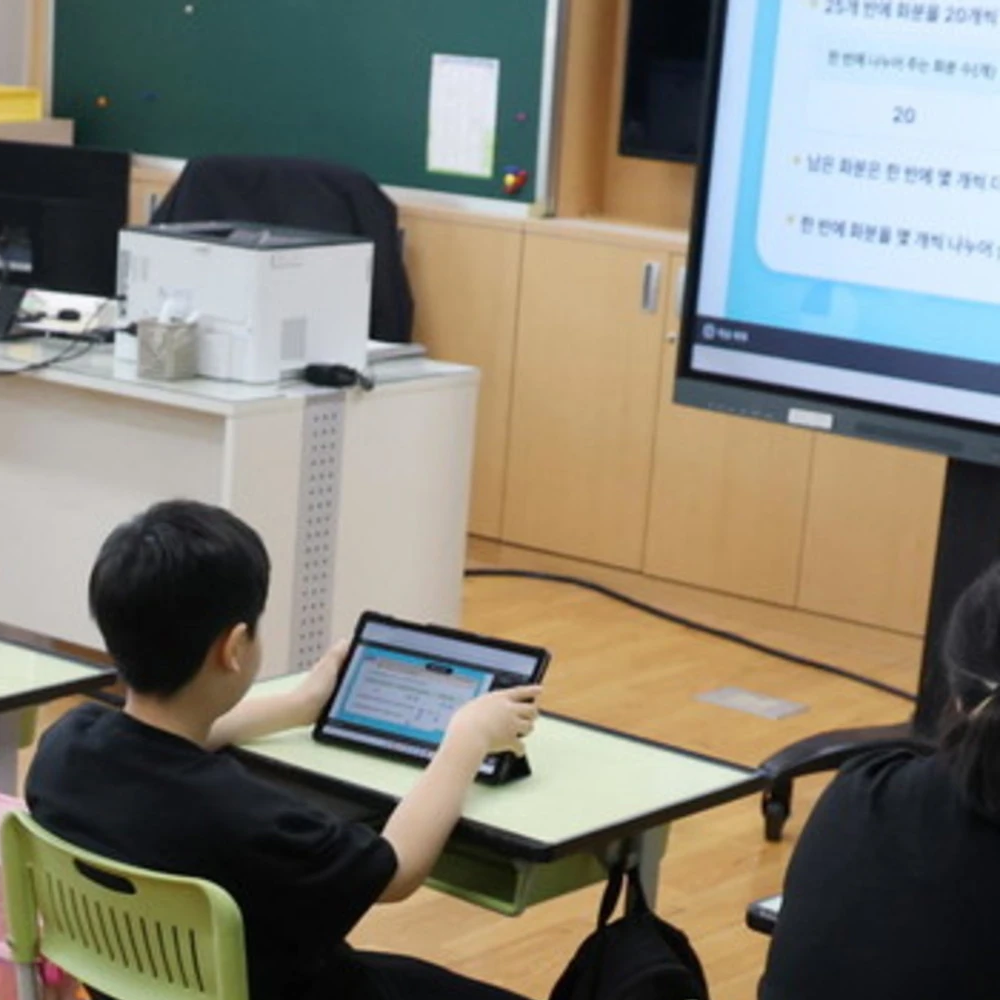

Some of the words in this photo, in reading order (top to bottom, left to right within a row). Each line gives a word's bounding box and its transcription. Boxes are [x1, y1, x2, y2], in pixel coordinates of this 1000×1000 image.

[893, 105, 917, 124] 20
[807, 152, 834, 174] 남은
[887, 161, 901, 182] 한
[904, 165, 933, 186] 번에
[938, 167, 952, 187] 몇
[957, 171, 986, 191] 개씩
[801, 214, 815, 235] 한
[818, 217, 846, 238] 번에
[851, 221, 892, 245] 화분을
[897, 227, 911, 246] 몇
[916, 230, 944, 251] 개씩
[949, 235, 994, 259] 나누어
